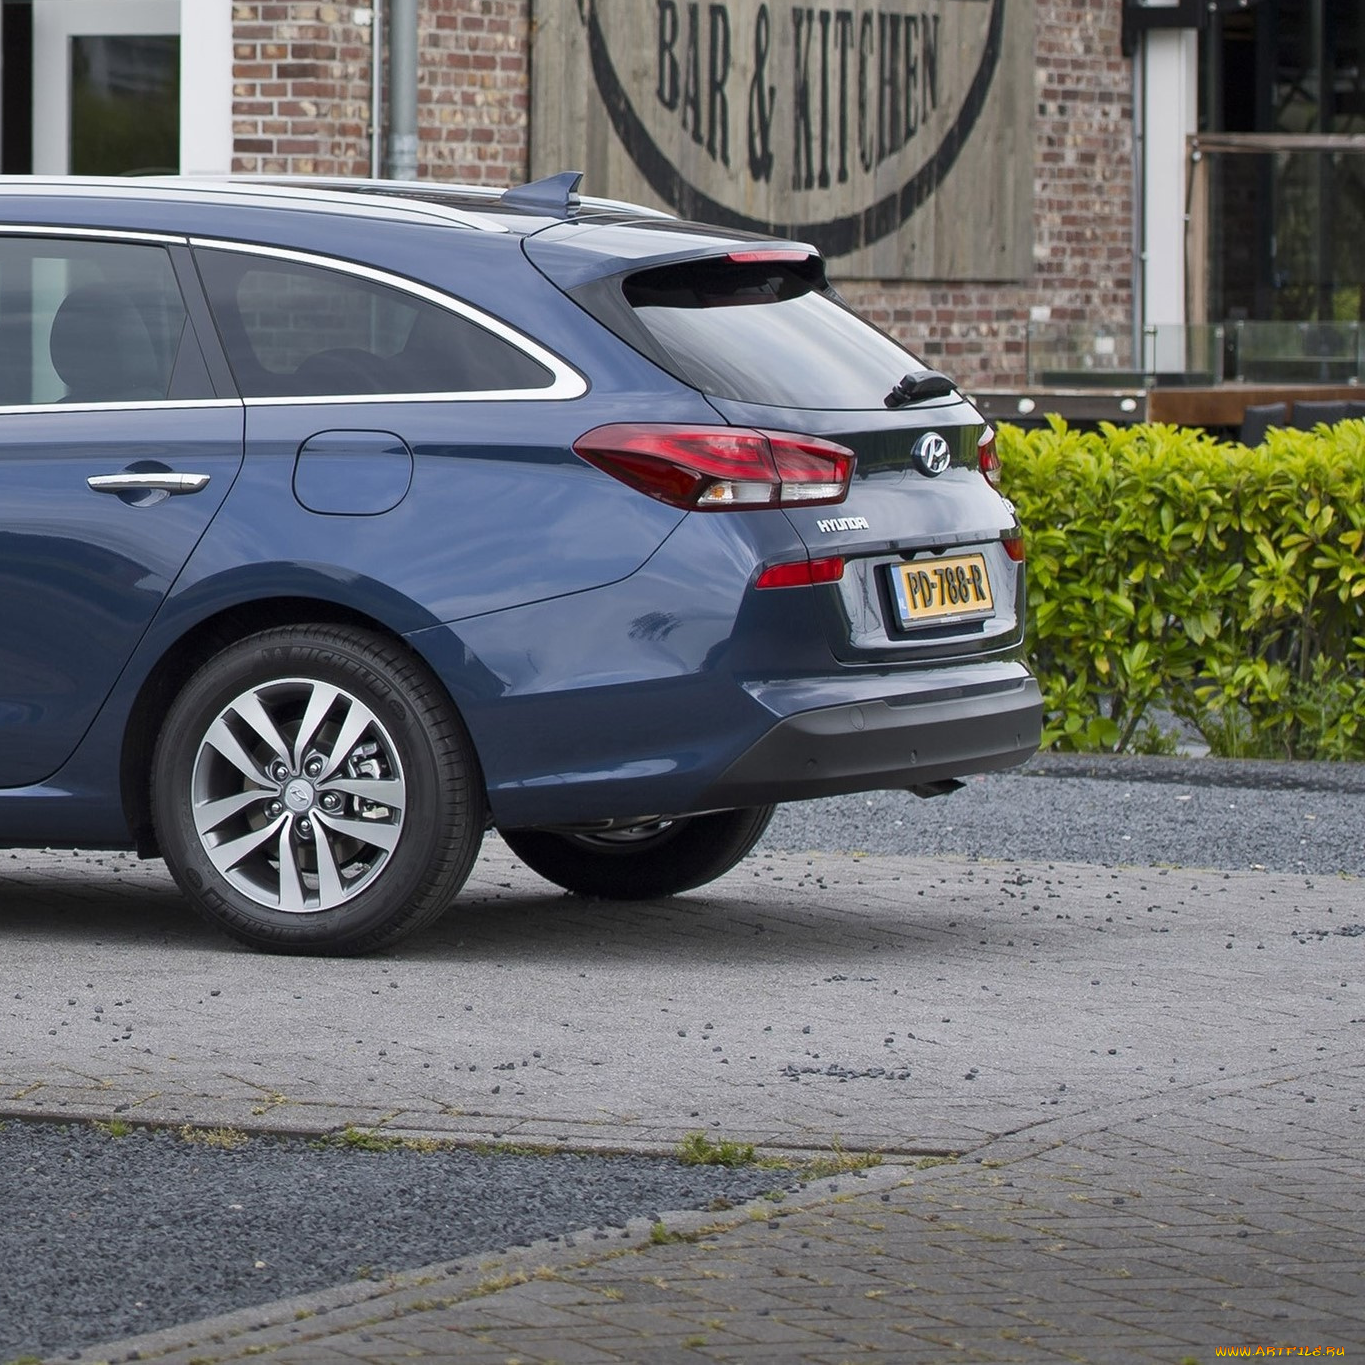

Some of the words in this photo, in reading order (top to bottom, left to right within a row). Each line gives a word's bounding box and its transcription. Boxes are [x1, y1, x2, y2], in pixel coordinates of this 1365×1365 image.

[656, 1, 731, 167] BAR
[749, 4, 777, 182] &
[792, 8, 940, 191] KITCHEN
[817, 516, 869, 532] HYUNDAI
[906, 564, 987, 610] PD-788-R
[290, 646, 391, 700] MICHELIN
